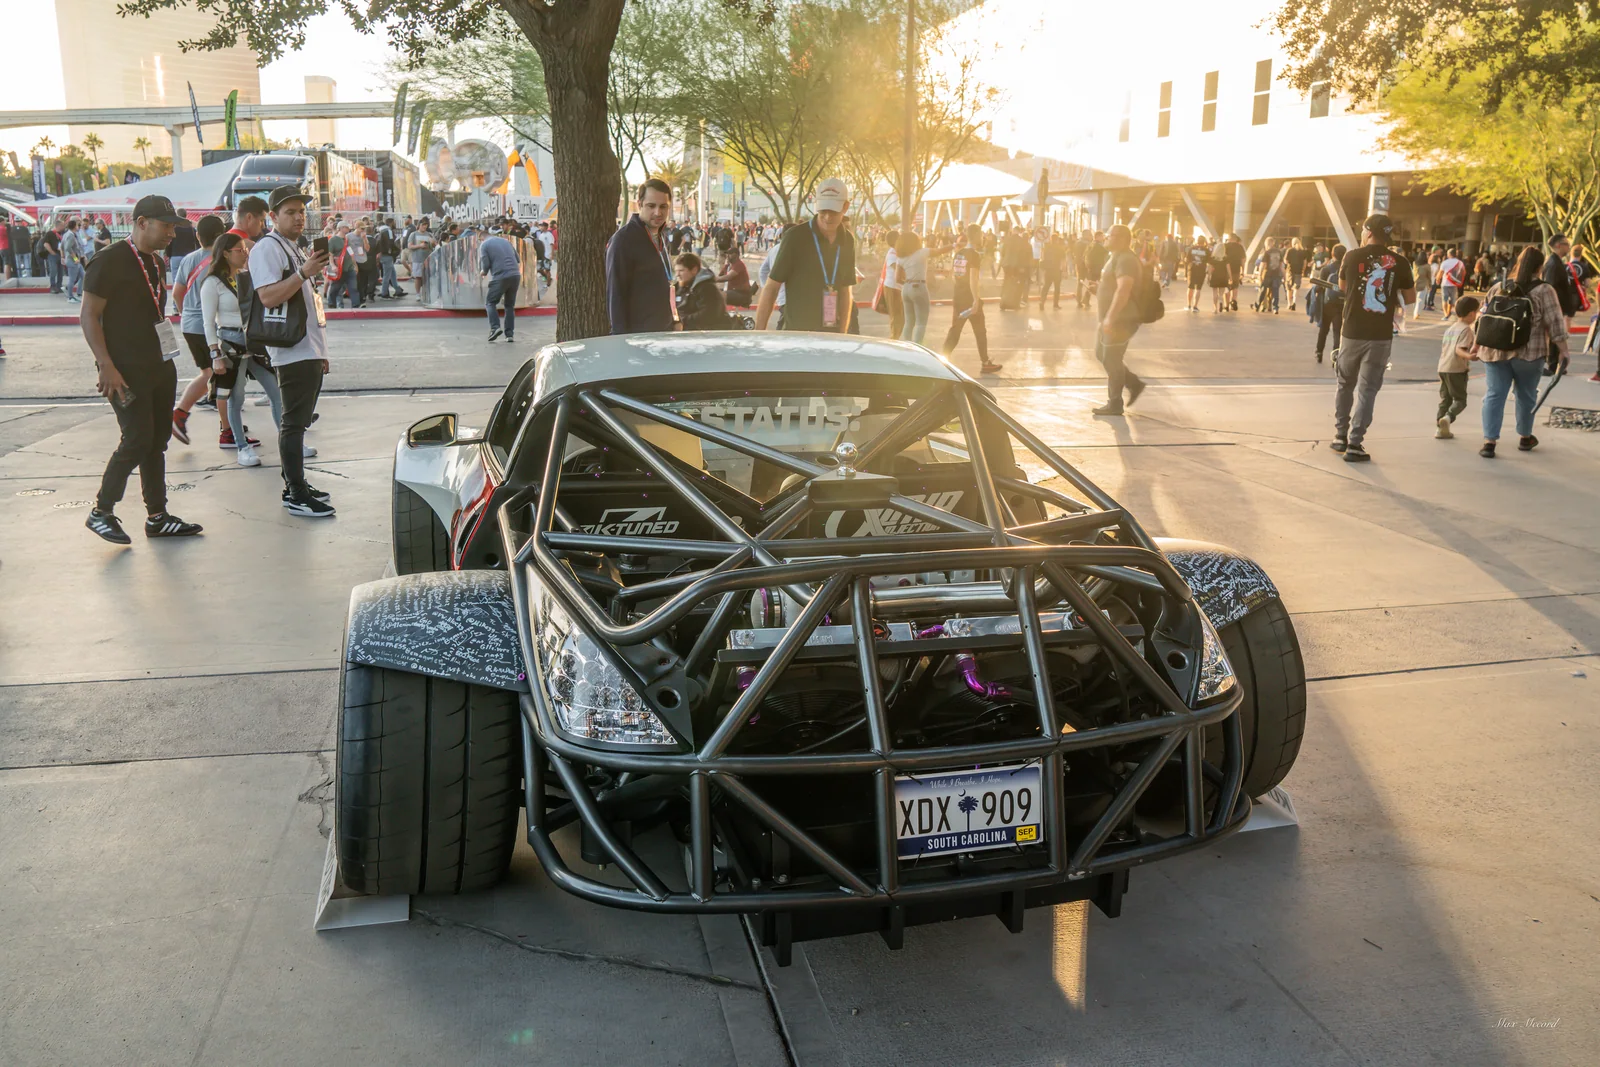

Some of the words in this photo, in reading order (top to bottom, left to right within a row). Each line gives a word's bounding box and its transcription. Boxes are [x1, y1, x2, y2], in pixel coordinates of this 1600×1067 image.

[900, 796, 951, 836] XDX
[982, 788, 1032, 826] 909
[927, 836, 958, 850] SOUTH
[961, 830, 1007, 846] CAROLINA
[1018, 827, 1034, 836] SEP
